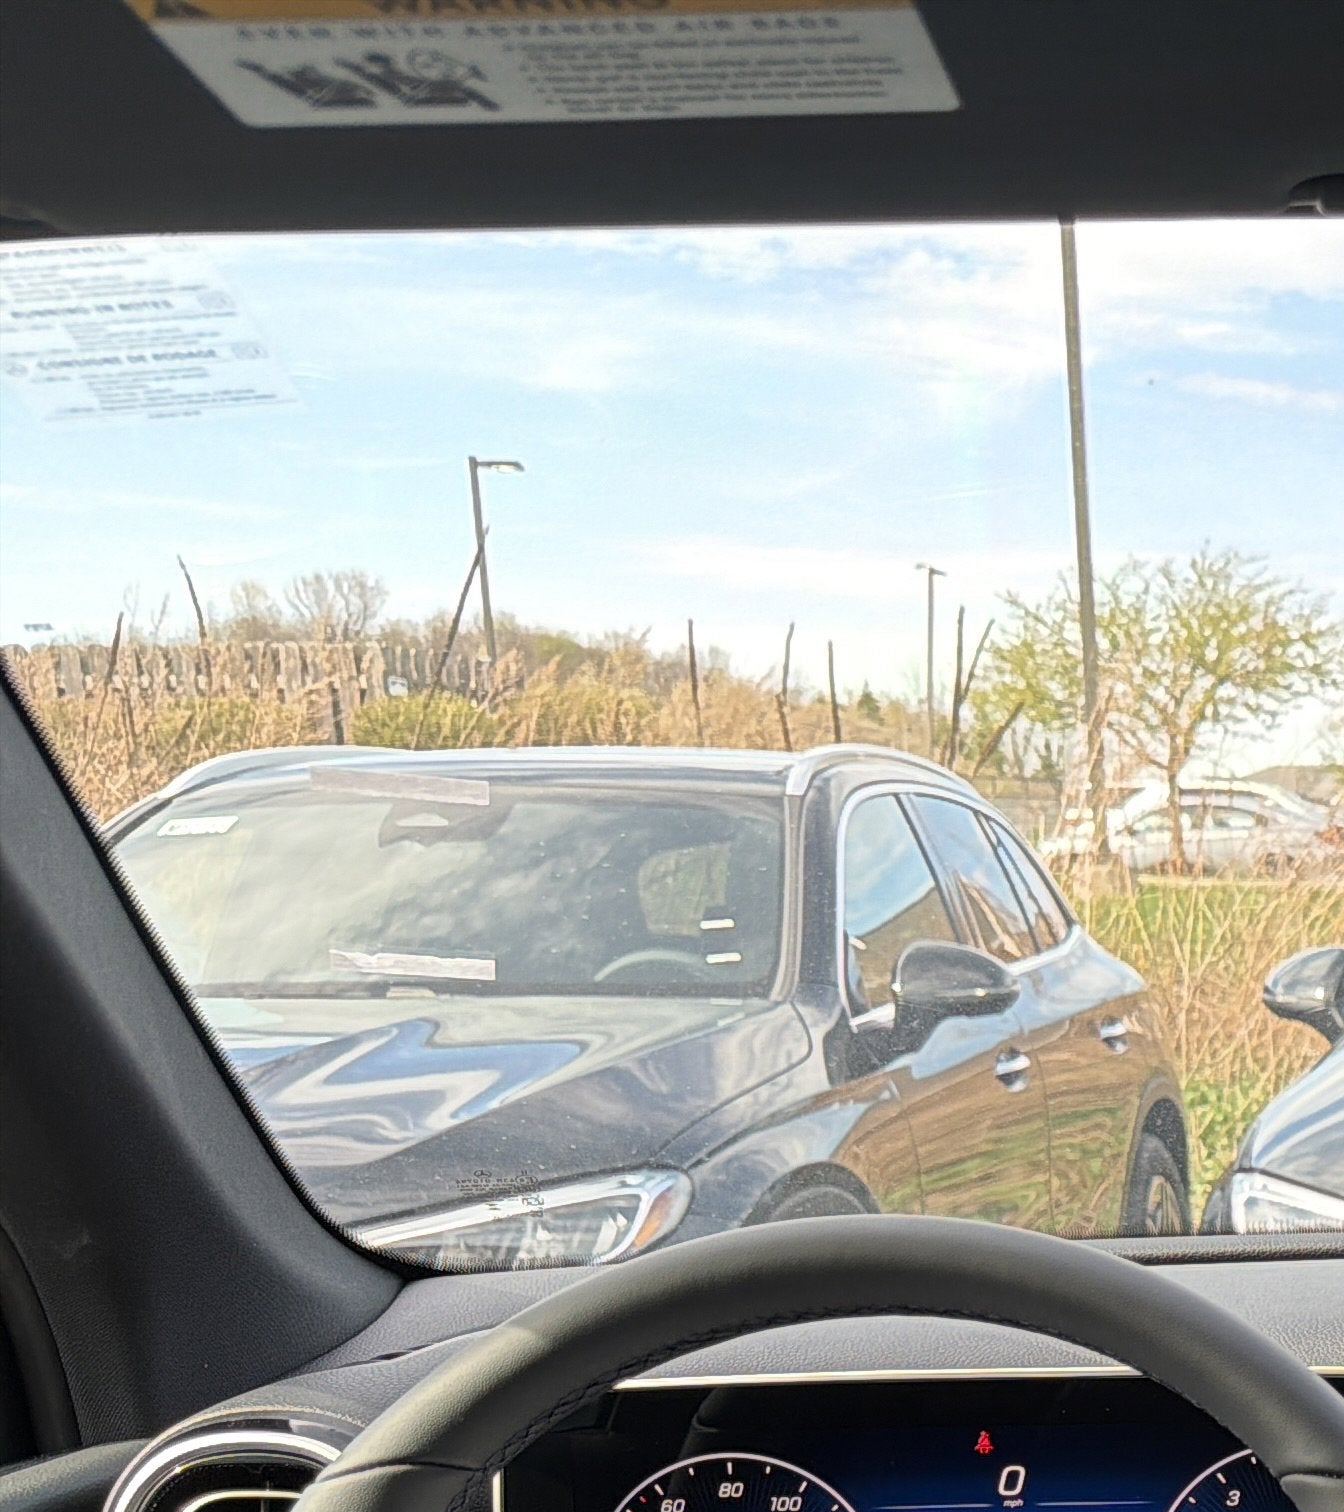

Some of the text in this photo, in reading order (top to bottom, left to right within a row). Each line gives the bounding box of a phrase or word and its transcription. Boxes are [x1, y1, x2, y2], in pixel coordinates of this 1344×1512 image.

[998, 1465, 1026, 1496] 0
[718, 1482, 744, 1498] 80
[770, 1496, 802, 1512] 100
[1225, 1490, 1241, 1507] 3
